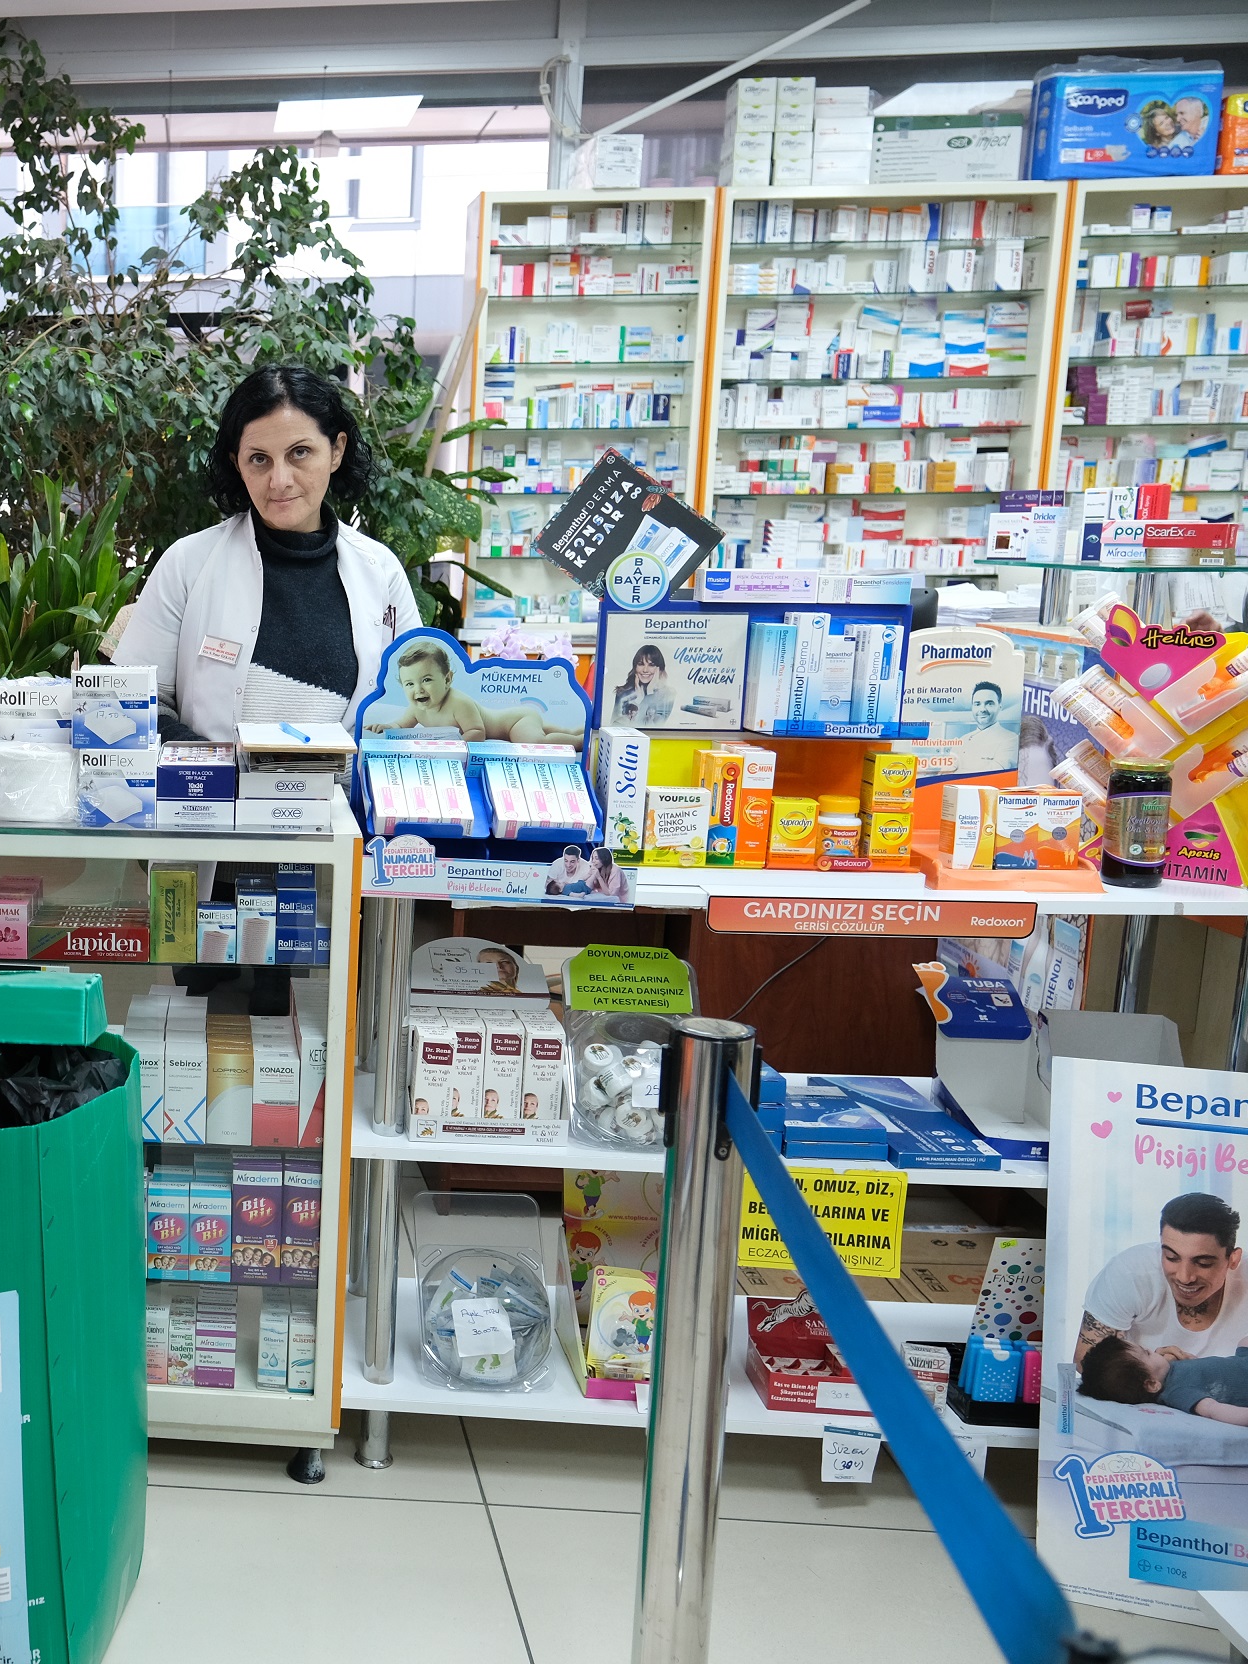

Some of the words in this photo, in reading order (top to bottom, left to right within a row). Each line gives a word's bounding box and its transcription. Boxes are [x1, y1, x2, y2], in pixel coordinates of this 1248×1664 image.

[552, 509, 587, 552] Bepanthol
[586, 469, 621, 510] DERMA
[1033, 513, 1056, 521] Driclor
[564, 480, 634, 561] SONSUZA
[1147, 527, 1184, 536] ScarEx
[573, 509, 624, 568] KADAR
[615, 576, 660, 585] BAYER
[645, 619, 709, 630] Bepanthol
[1142, 630, 1215, 647] Heilung
[921, 644, 992, 659] Pharmaton
[870, 650, 881, 681] Derma
[481, 672, 542, 683] MÜKEMMEL
[480, 684, 528, 694] KORUMA
[791, 675, 805, 730] Bepanthol
[799, 640, 808, 673] Derma
[932, 696, 955, 704] Etme!
[824, 724, 881, 736] Bepanthol
[930, 757, 953, 766] G115
[616, 743, 639, 798] Selin
[722, 783, 735, 824] Redoxon
[999, 796, 1038, 806] Pharmaton
[1043, 798, 1079, 807] Pharmaton
[658, 811, 690, 820] VİTAMİN
[658, 819, 684, 829] ÇİNKO
[658, 824, 697, 833] PROPOLİS
[384, 854, 433, 864] NUMARALI
[1178, 847, 1220, 860] Apexis
[833, 859, 869, 868] Redoxon
[385, 864, 435, 877] TERCİHİ
[447, 865, 502, 877] Bepanthol
[505, 868, 530, 879] Baby
[506, 881, 527, 895] Önle!
[743, 901, 864, 920] GARDINIZI
[871, 903, 941, 924] SEÇİN
[795, 921, 830, 931] GERİSİ
[832, 922, 885, 933] ÇÖZÜLÜR
[971, 916, 1024, 928] Redoxon
[67, 932, 142, 956] lapiden
[590, 974, 608, 982] BEL
[610, 973, 669, 984] AĞRILARINA
[963, 980, 1005, 988] TUBA
[577, 985, 634, 994] ECZACINIZA
[636, 987, 684, 998] DANIŞINIZ
[593, 997, 609, 1007] (AT
[611, 998, 669, 1008] KESTANESİ)
[1137, 1084, 1248, 1119] Bepan
[1135, 1134, 1207, 1177] Pişiği
[814, 1179, 861, 1194] OMUZ,
[865, 1178, 894, 1199] DİZ,
[241, 1197, 266, 1212] Bit
[248, 1207, 272, 1222] Bit
[813, 1204, 865, 1222] ILARINA
[871, 1208, 889, 1222] VE
[153, 1218, 175, 1231] Bit
[196, 1219, 217, 1232] Bit
[160, 1227, 182, 1241] Bit
[202, 1228, 224, 1242] Bit
[742, 1226, 781, 1241] MİGR
[993, 1273, 1044, 1285] FASHIO
[1088, 1482, 1176, 1500] NUMARALI
[1091, 1499, 1182, 1520] TERCİHİ
[1136, 1527, 1229, 1556] Bepanthol
[1167, 1566, 1187, 1579] 100g
